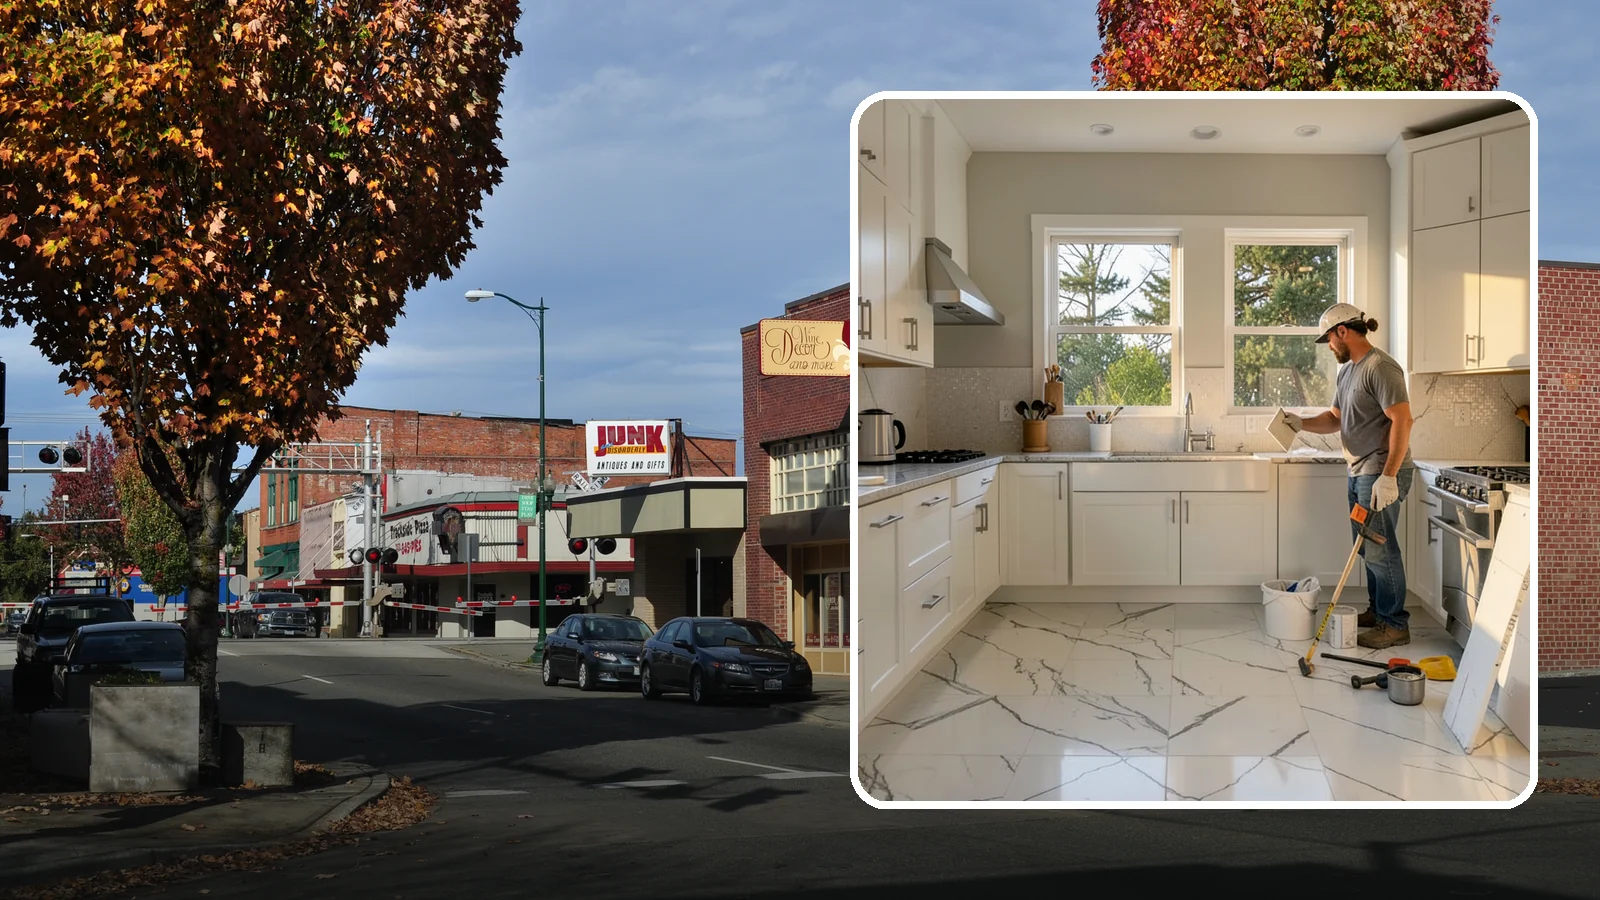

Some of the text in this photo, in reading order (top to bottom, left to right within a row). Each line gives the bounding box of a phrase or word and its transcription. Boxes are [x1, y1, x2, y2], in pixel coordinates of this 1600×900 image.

[595, 425, 665, 457] JUNK
[607, 446, 646, 454] DISORDERLY
[597, 460, 666, 470] ANTIQUES AND GIFTS
[414, 519, 429, 535] Pizza
